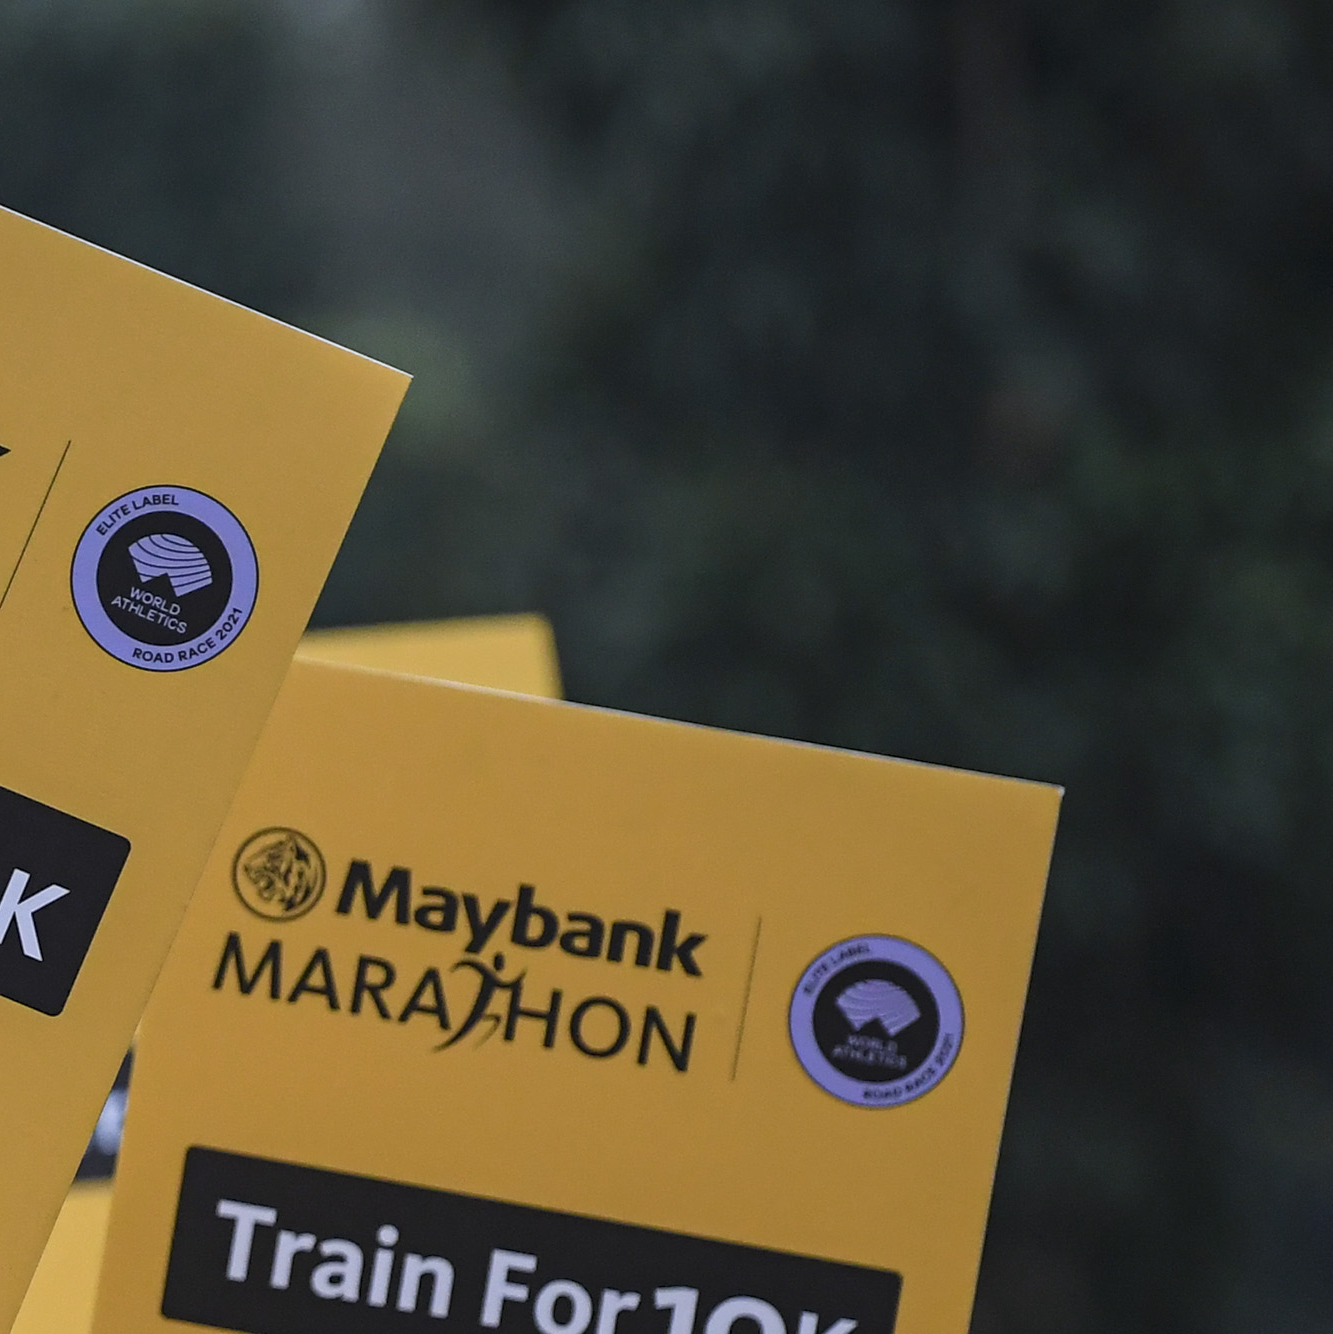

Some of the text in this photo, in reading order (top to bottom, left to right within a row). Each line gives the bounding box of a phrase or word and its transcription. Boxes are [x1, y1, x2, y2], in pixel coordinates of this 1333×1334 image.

[96, 494, 179, 536] ELITE LABEL
[111, 596, 187, 634] ATHLETICS
[130, 587, 181, 616] WORLD
[132, 607, 243, 663] ROAD RACE 2021
[336, 860, 708, 978] Maybank
[212, 932, 696, 1074] MARATHON
[215, 1199, 456, 1320] Train
